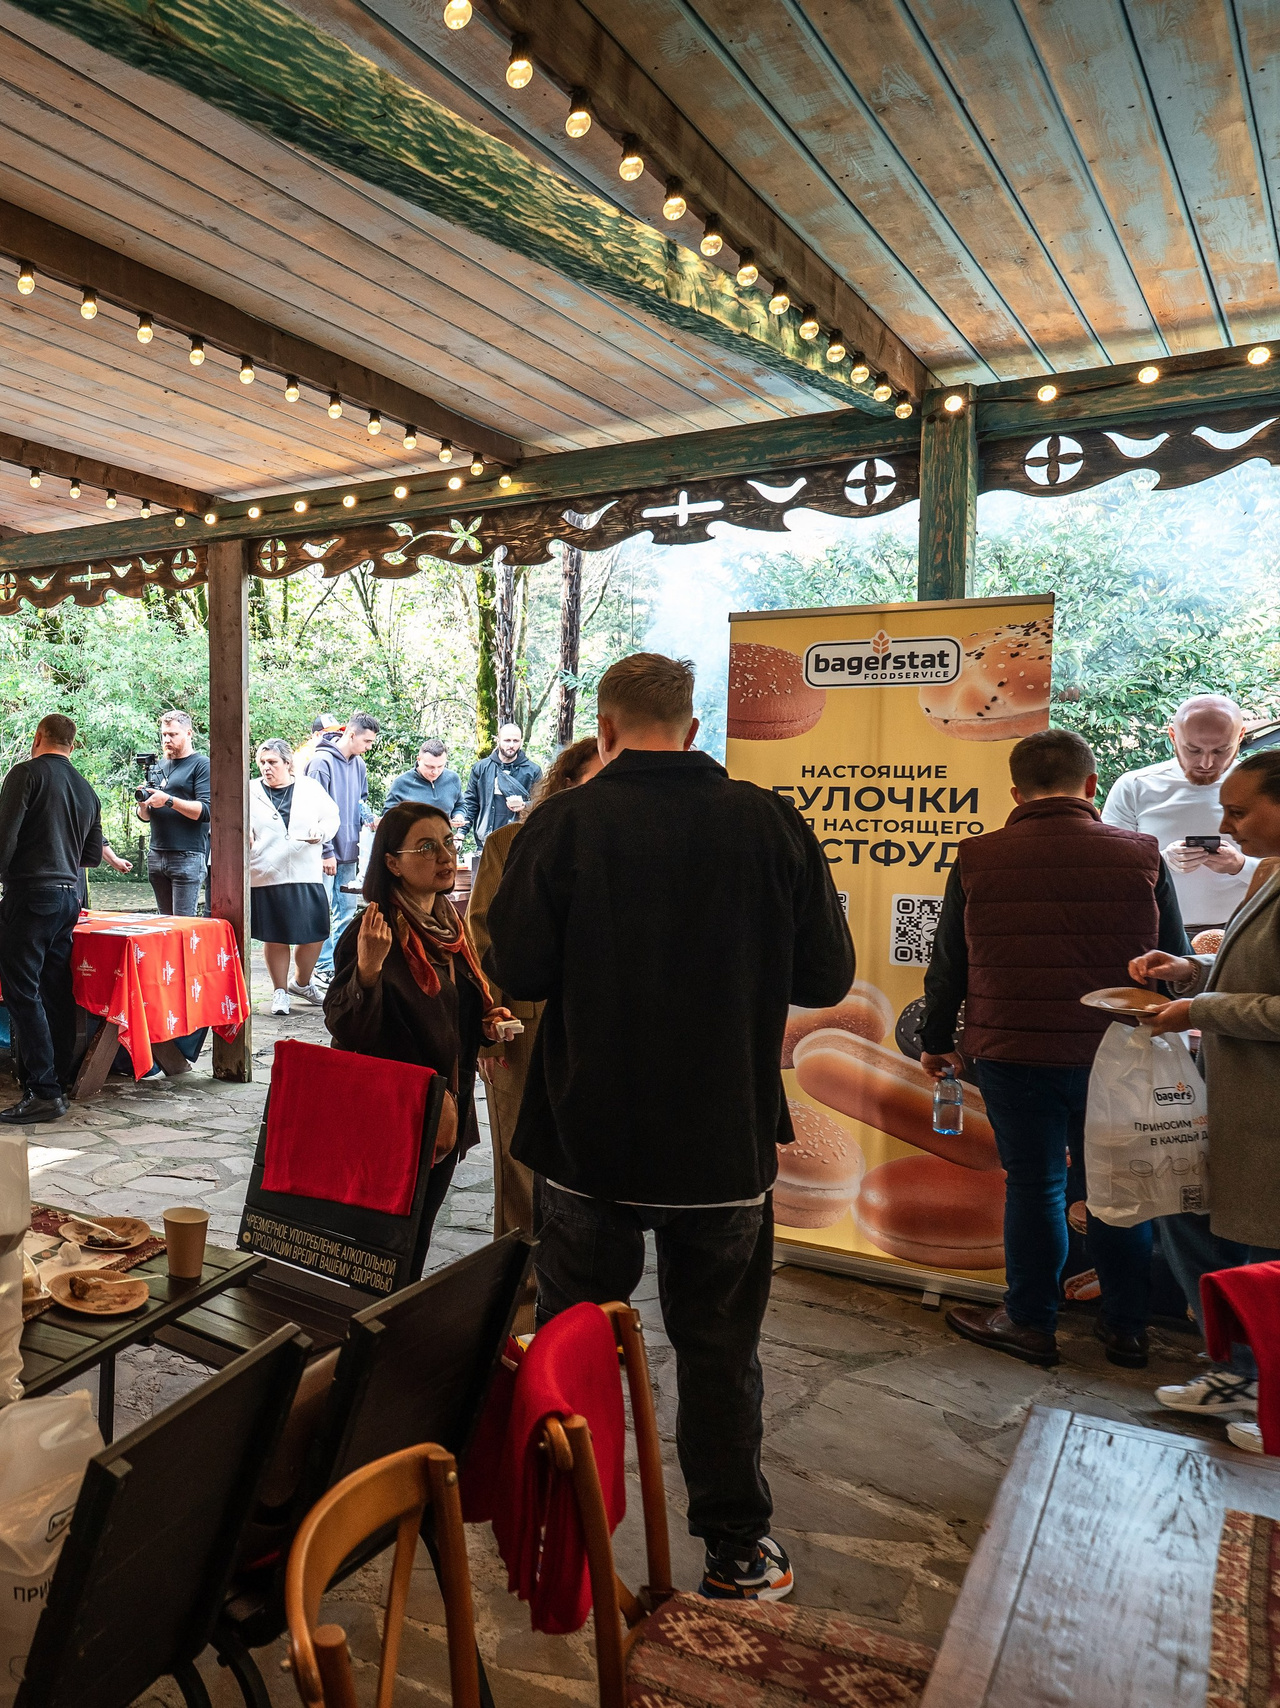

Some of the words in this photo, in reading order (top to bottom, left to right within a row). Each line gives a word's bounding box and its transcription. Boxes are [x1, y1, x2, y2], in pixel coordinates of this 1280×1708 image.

[814, 649, 950, 677] bagerstat
[864, 670, 949, 680] FOODSERVICE
[801, 765, 948, 780] НАСТОЯЩИЕ
[823, 818, 984, 836] НАСТОЯЩЕГО
[819, 838, 959, 872] СТФУД
[1155, 1091, 1192, 1102] bagers
[1134, 1120, 1192, 1132] ПРИНОСИМ
[1150, 1137, 1157, 1146] В
[246, 1213, 288, 1240] ЧРЕЗМЕРНОЕ
[289, 1227, 342, 1258] УПОТРЕБЛЕНИЕ
[341, 1245, 397, 1276] АЛКОГОЛЬНОЙ
[251, 1231, 293, 1257] ПРОДУКЦИИ
[292, 1245, 320, 1267] ВРЕДИТ
[320, 1254, 351, 1279] ВАШЕМУ
[351, 1266, 393, 1293] ЗДОРОВЬЮ
